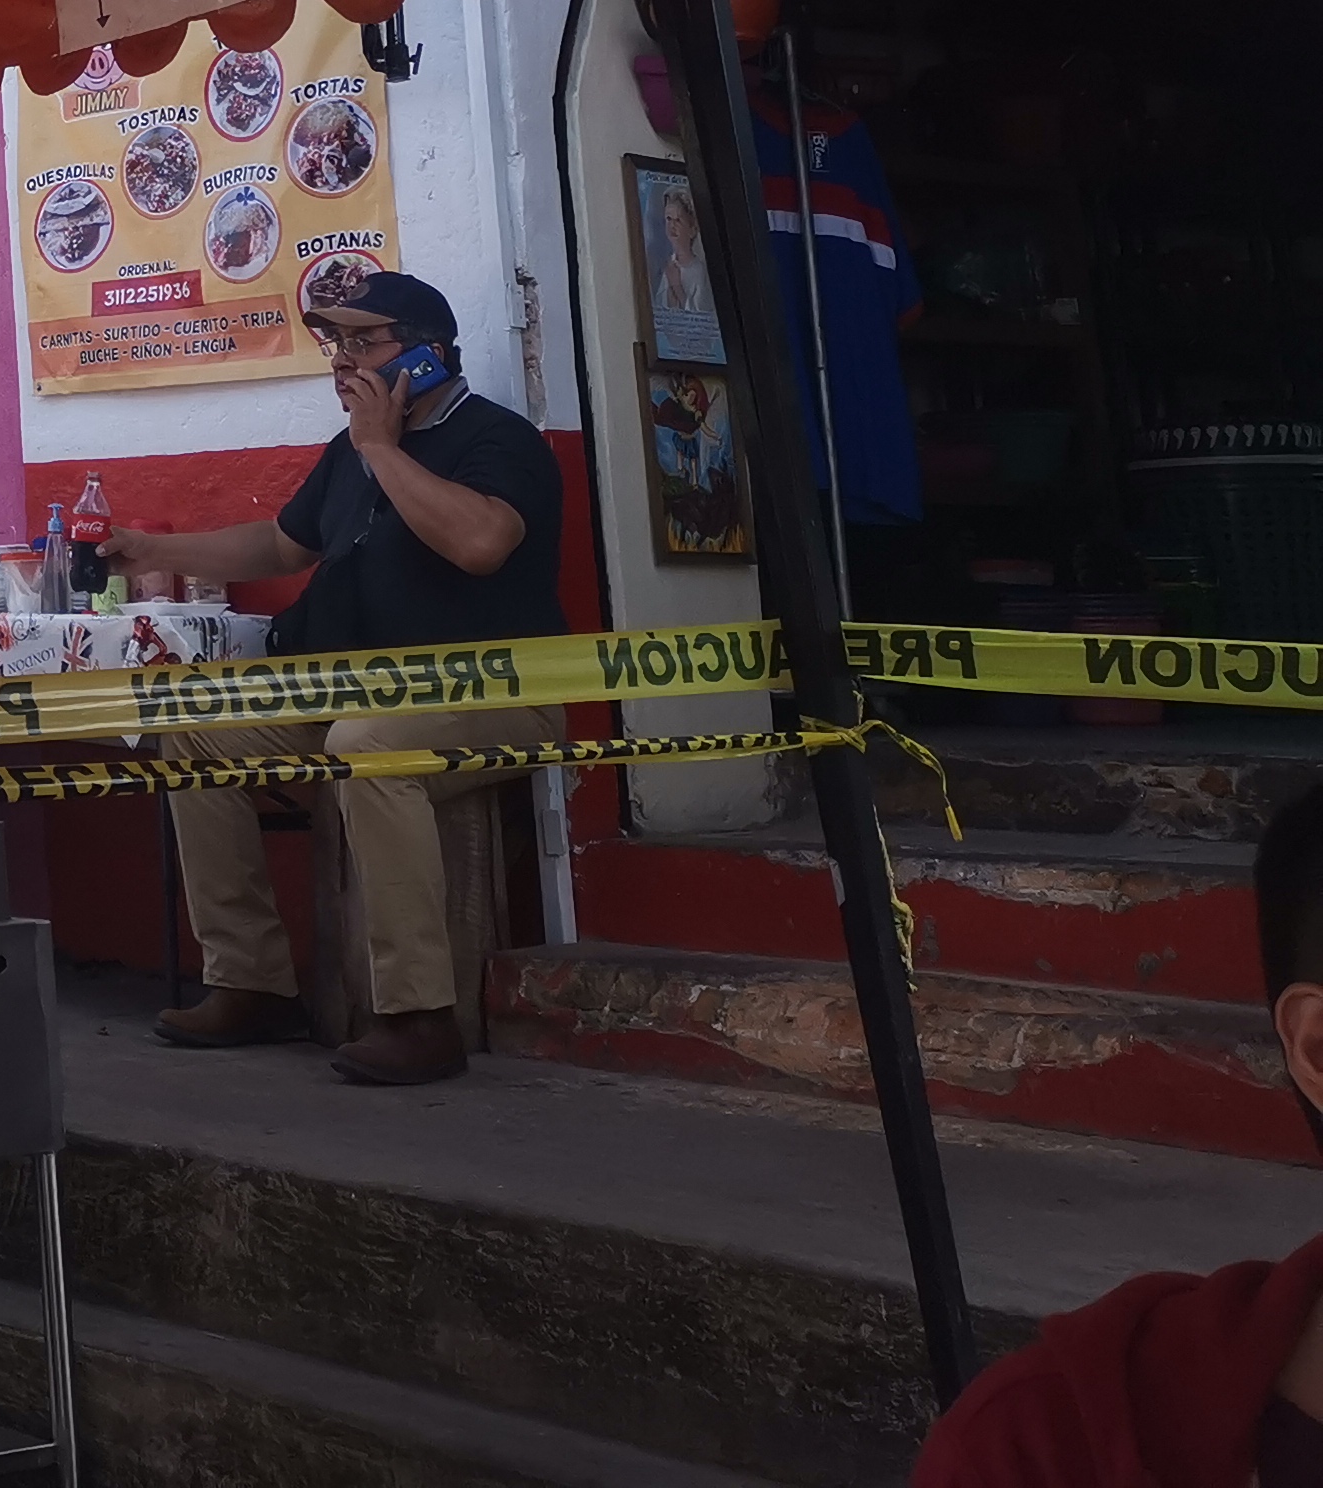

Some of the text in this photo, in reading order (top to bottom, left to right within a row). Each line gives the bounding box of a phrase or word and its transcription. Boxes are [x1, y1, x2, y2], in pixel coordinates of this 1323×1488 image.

[72, 88, 128, 117] JIMMY
[291, 77, 365, 105] TORTAS
[118, 107, 199, 135] TOSTADAS
[26, 165, 115, 192] QUESADILLAS
[203, 165, 277, 195] BURRITOS
[297, 232, 383, 259] BOTANAS
[119, 264, 161, 277] ORDENA
[104, 282, 190, 307] 3112251936
[40, 310, 285, 350] CARNITAS SURTIDO CUERITO TRIPA
[80, 348, 119, 364] BUCHE
[184, 337, 237, 354] LENGUA
[7, 646, 57, 675] LONDON
